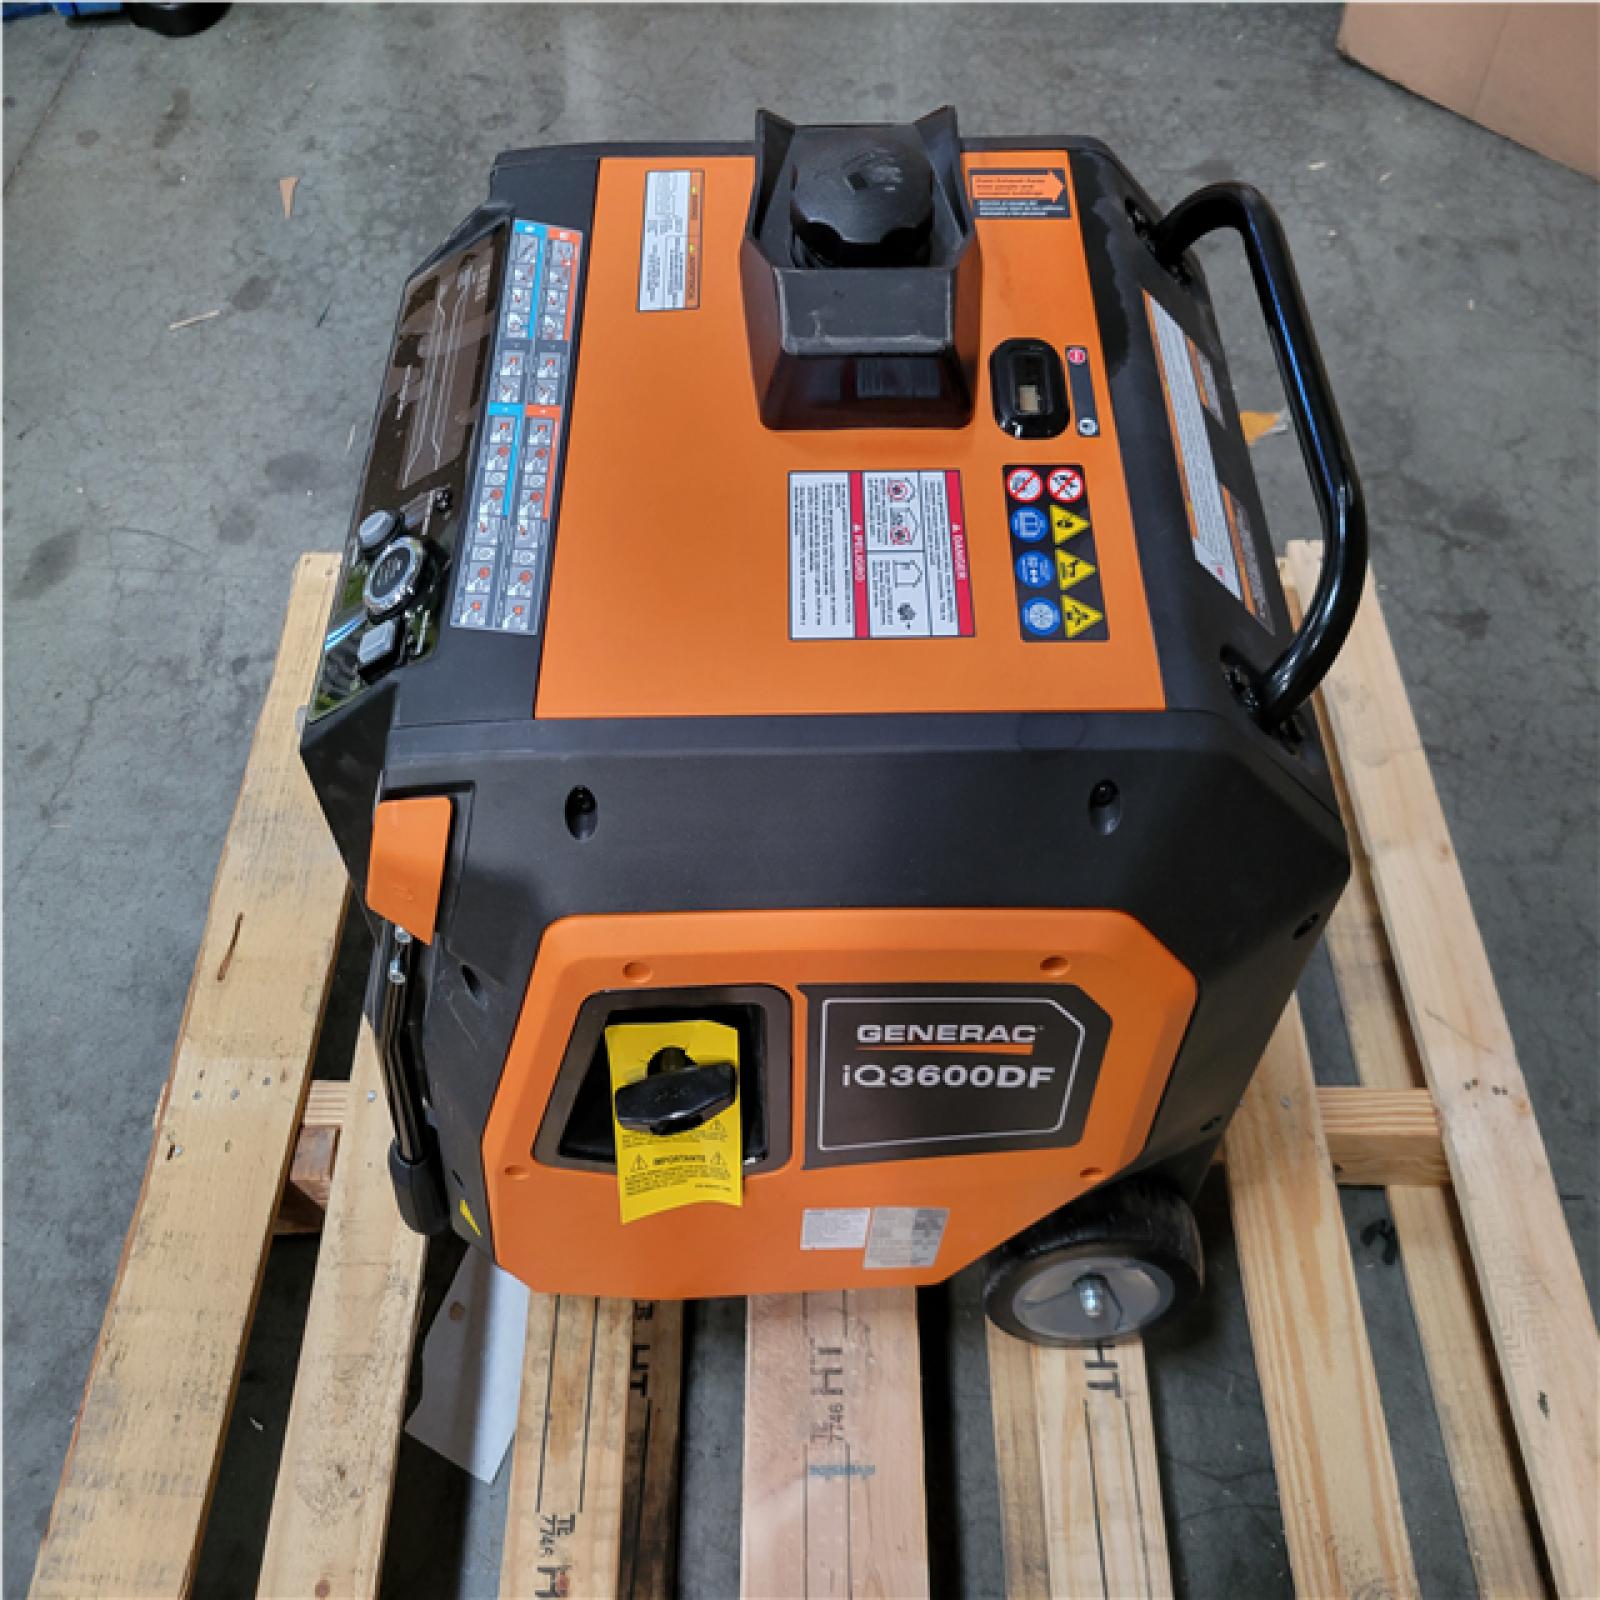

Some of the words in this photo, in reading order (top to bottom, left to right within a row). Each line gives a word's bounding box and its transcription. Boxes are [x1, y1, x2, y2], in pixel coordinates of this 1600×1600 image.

[857, 1024, 1036, 1042] GENERAC
[842, 1064, 1055, 1088] iQ3600DF
[810, 1337, 843, 1396] HT
